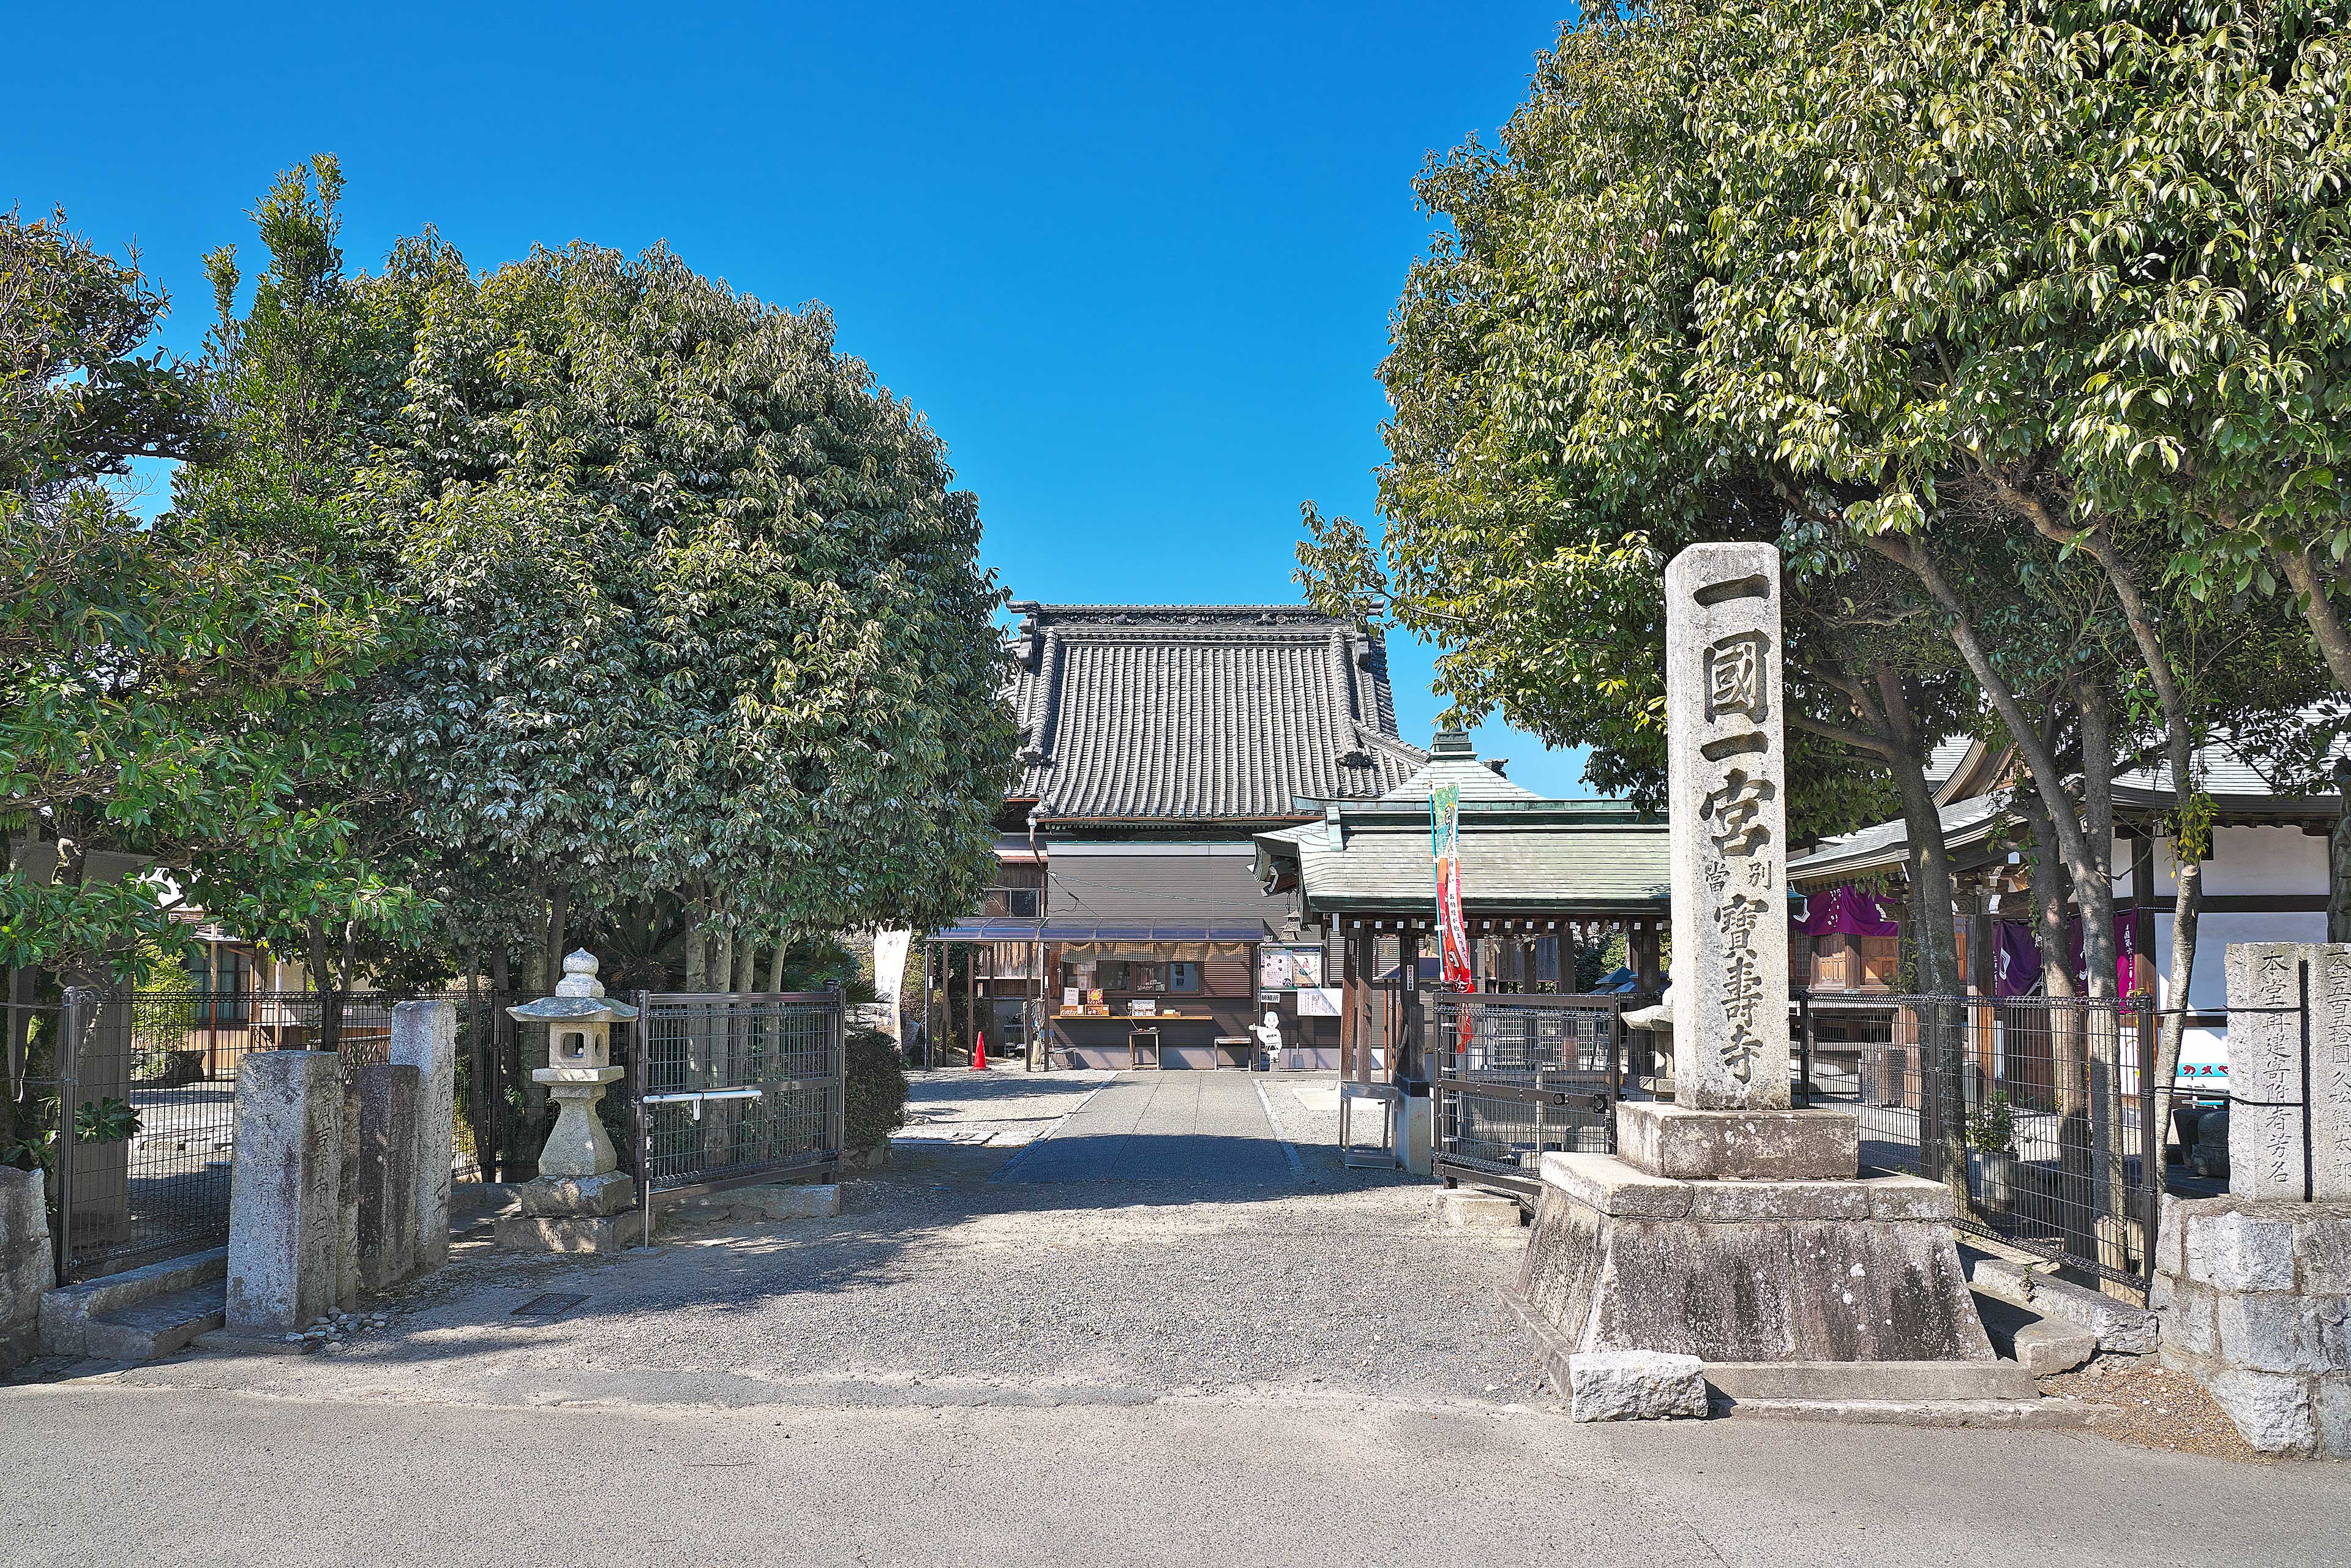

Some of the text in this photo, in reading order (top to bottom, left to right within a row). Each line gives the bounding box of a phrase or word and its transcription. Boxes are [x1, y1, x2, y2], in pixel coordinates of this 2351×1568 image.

[1693, 574, 1775, 858] 一國一宮
[1714, 894, 1769, 1084] 寶壽寺
